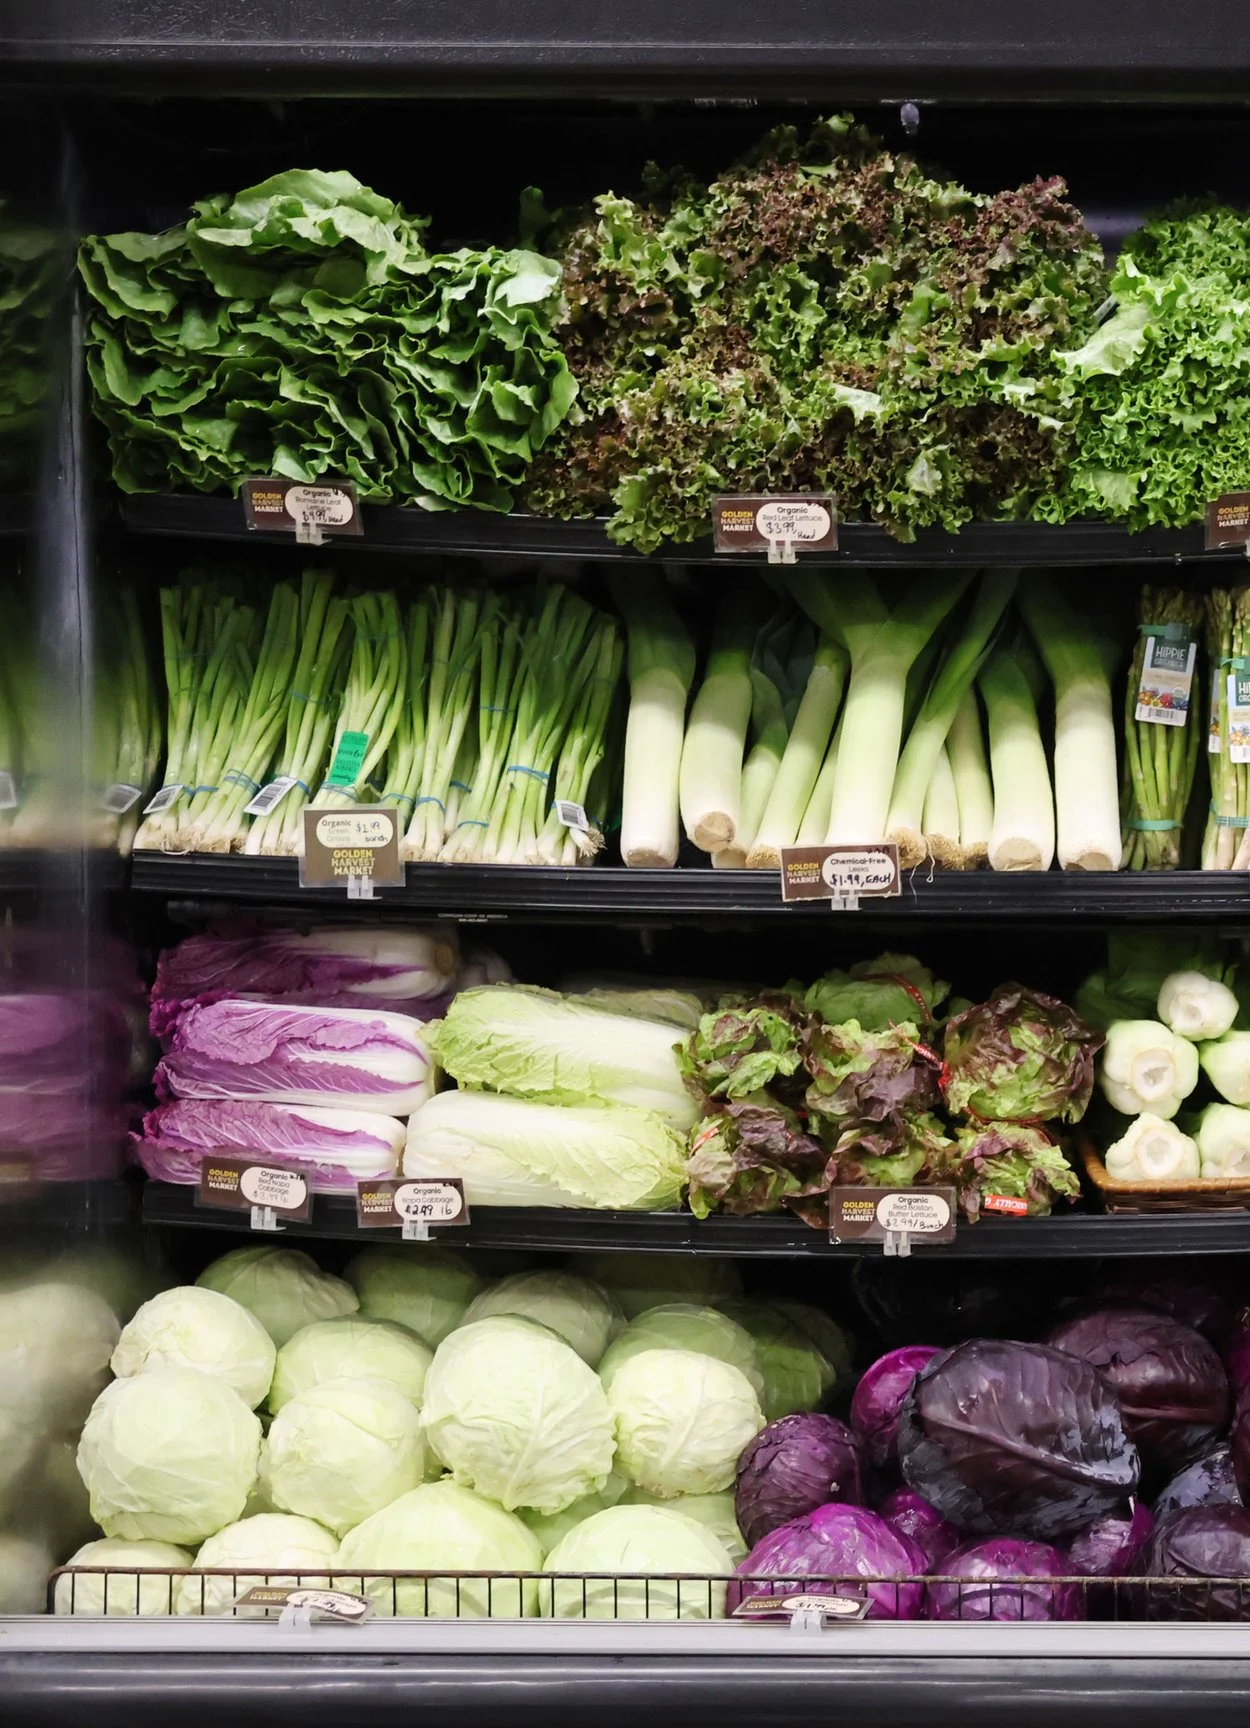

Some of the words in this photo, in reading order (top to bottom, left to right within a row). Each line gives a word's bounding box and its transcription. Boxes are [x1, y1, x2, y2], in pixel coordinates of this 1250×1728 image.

[303, 489, 331, 498] Organic
[777, 507, 808, 515] Organic
[1219, 505, 1249, 515] GOLDEN
[1217, 512, 1250, 521] HARVEST
[1219, 518, 1248, 528] MARKET
[322, 820, 351, 828] Organic
[333, 850, 373, 858] GOLDEN
[331, 858, 375, 867] HARVEST
[831, 858, 887, 866] Chemical-Free
[334, 866, 374, 876] MARKET
[788, 863, 819, 871] GOLDEN
[787, 870, 821, 878] HARVEST
[789, 876, 820, 884] MARKET
[209, 1169, 239, 1178] GOLDEN
[261, 1170, 289, 1180] Organic
[208, 1176, 240, 1184] HARVEST
[209, 1182, 238, 1191] MARKET
[413, 1188, 442, 1196] Organic
[361, 1199, 394, 1207] HARVEST
[422, 1196, 454, 1204] Cabbage
